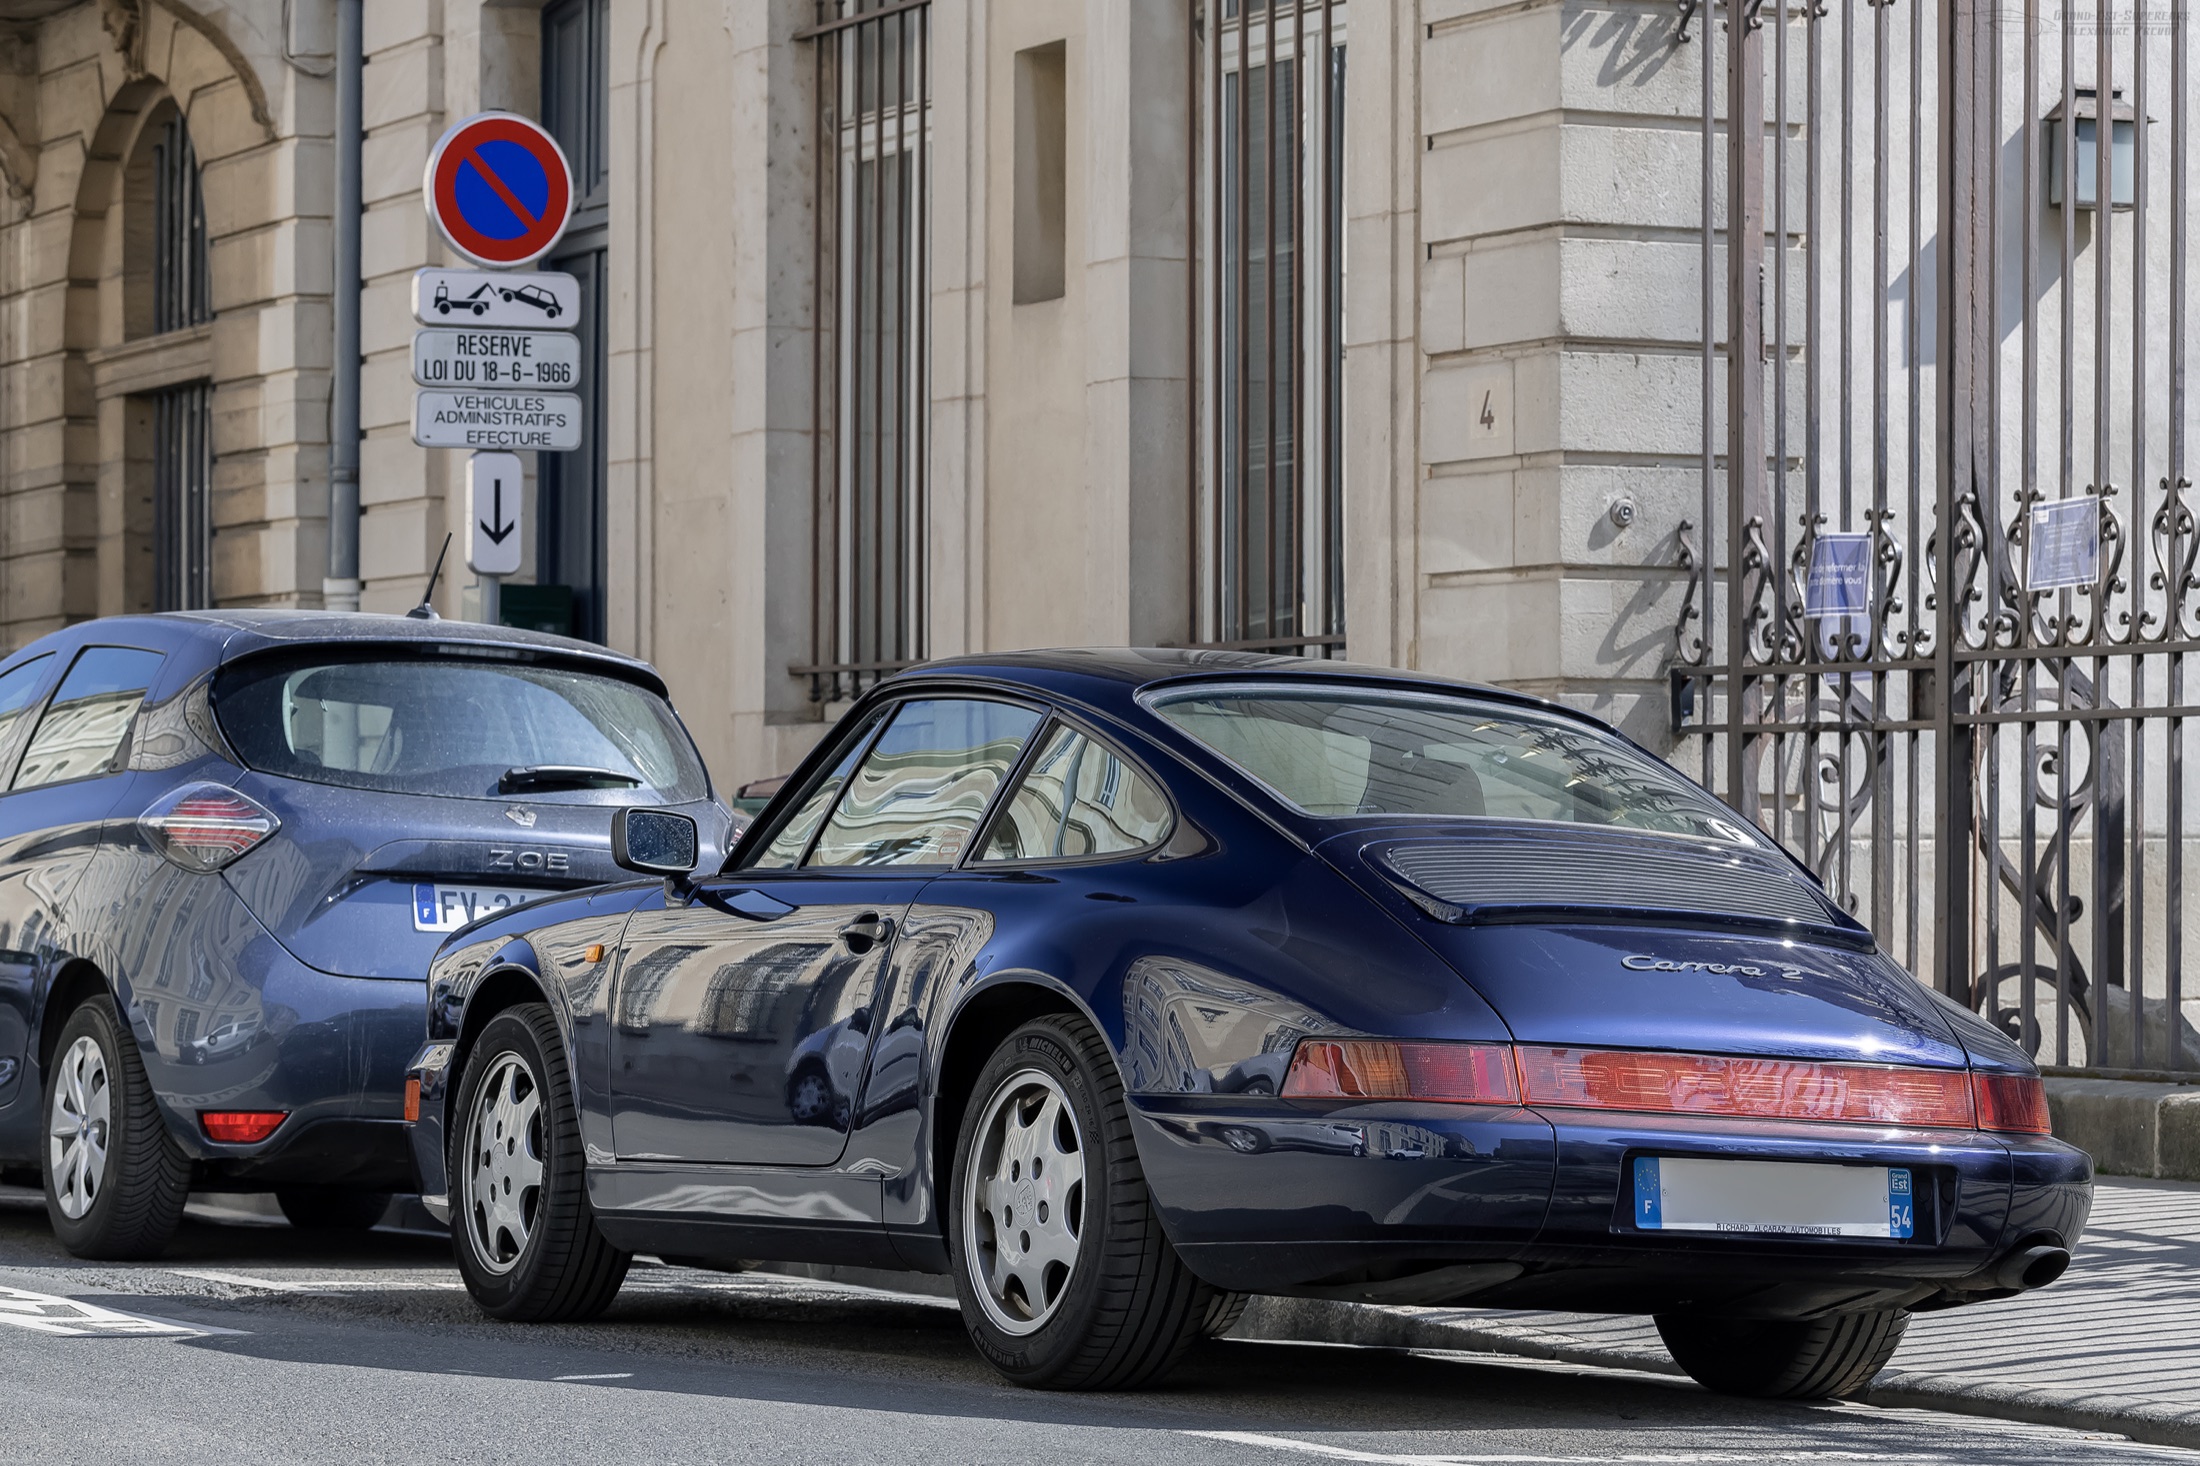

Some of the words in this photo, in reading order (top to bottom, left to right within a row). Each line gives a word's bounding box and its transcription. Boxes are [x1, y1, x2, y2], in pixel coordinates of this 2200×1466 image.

[456, 334, 532, 358] RESERVE
[423, 359, 448, 381] LOI
[453, 360, 476, 382] DU
[481, 361, 571, 384] 18-6-1966
[454, 396, 545, 412] VEHICULES
[1480, 389, 1495, 430] 4
[434, 411, 567, 428] ADMINISTRATIFS
[466, 430, 552, 446] EFECTURE
[490, 850, 569, 870] ZOE
[423, 908, 430, 918] F
[1621, 955, 1767, 977] Carrera
[1781, 967, 1804, 980] 2
[1029, 1038, 1072, 1072] MICHELIN
[1892, 1179, 1908, 1189] Est
[1645, 1200, 1652, 1214] F
[1891, 1205, 1911, 1229] 54
[1716, 1223, 1749, 1231] RICHARD
[1754, 1225, 1787, 1233] ALCARAZ
[1790, 1227, 1842, 1235] AUTOMOBILES
